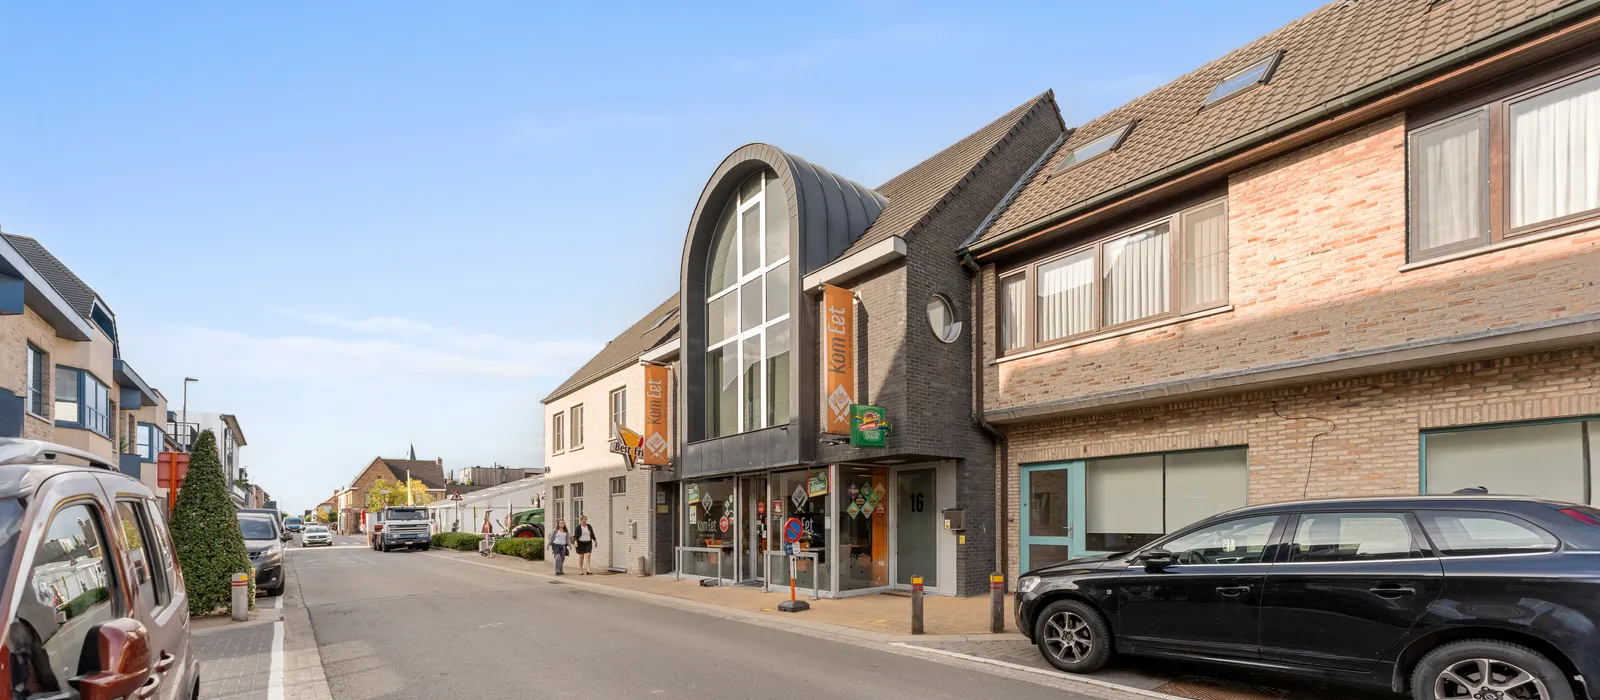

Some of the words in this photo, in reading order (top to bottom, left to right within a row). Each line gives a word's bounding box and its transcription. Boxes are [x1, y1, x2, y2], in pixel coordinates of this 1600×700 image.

[827, 305, 846, 335] Eet
[828, 337, 846, 374] Kom
[646, 378, 662, 399] Eet
[647, 400, 662, 425] Kom
[614, 442, 632, 454] Best
[910, 492, 924, 513] 16
